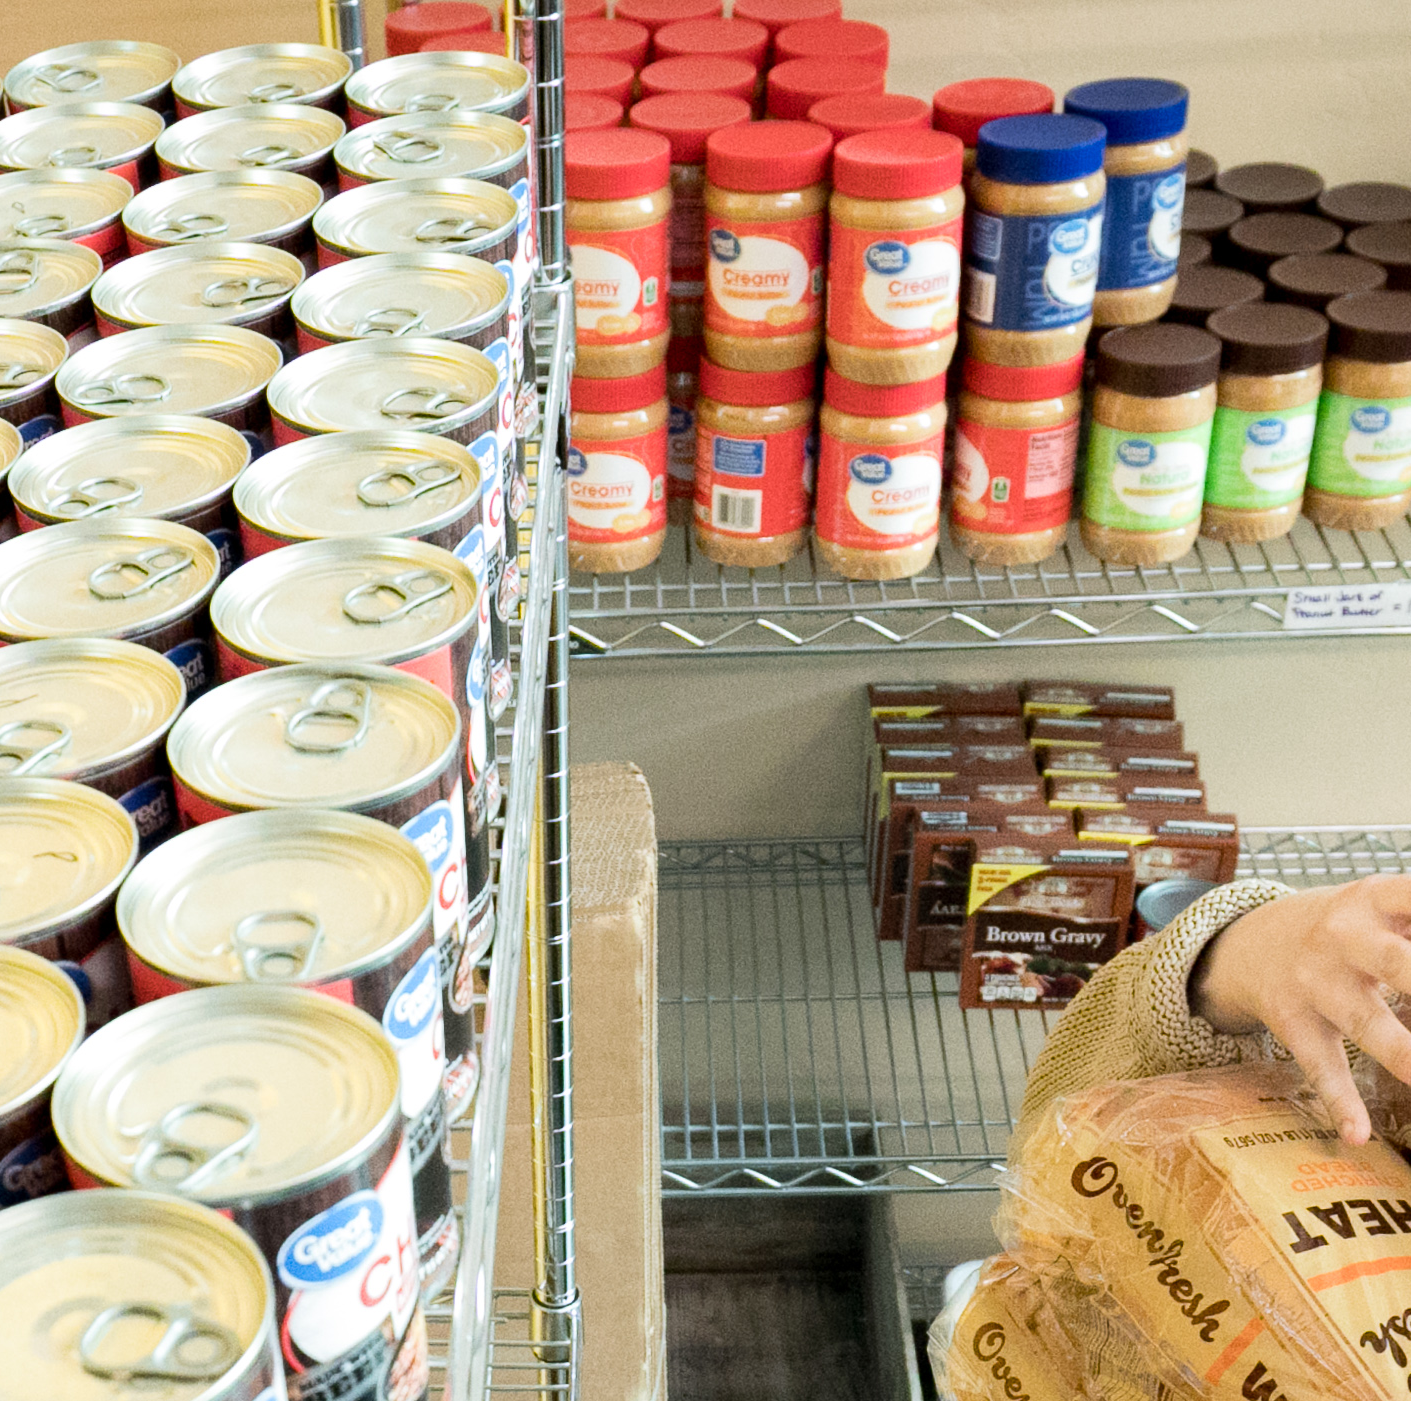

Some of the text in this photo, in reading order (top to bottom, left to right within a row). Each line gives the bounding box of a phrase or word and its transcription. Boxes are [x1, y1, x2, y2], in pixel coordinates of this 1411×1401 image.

[870, 248, 904, 263] Great
[723, 268, 790, 287] Creamy
[575, 279, 621, 296] eamy
[1355, 411, 1387, 423] Great
[855, 461, 886, 473] Great
[570, 480, 634, 498] Creamy
[986, 926, 1107, 948] Brown Gravy
[1223, 1133, 1255, 1149] 567g
[294, 1206, 373, 1266] Great
